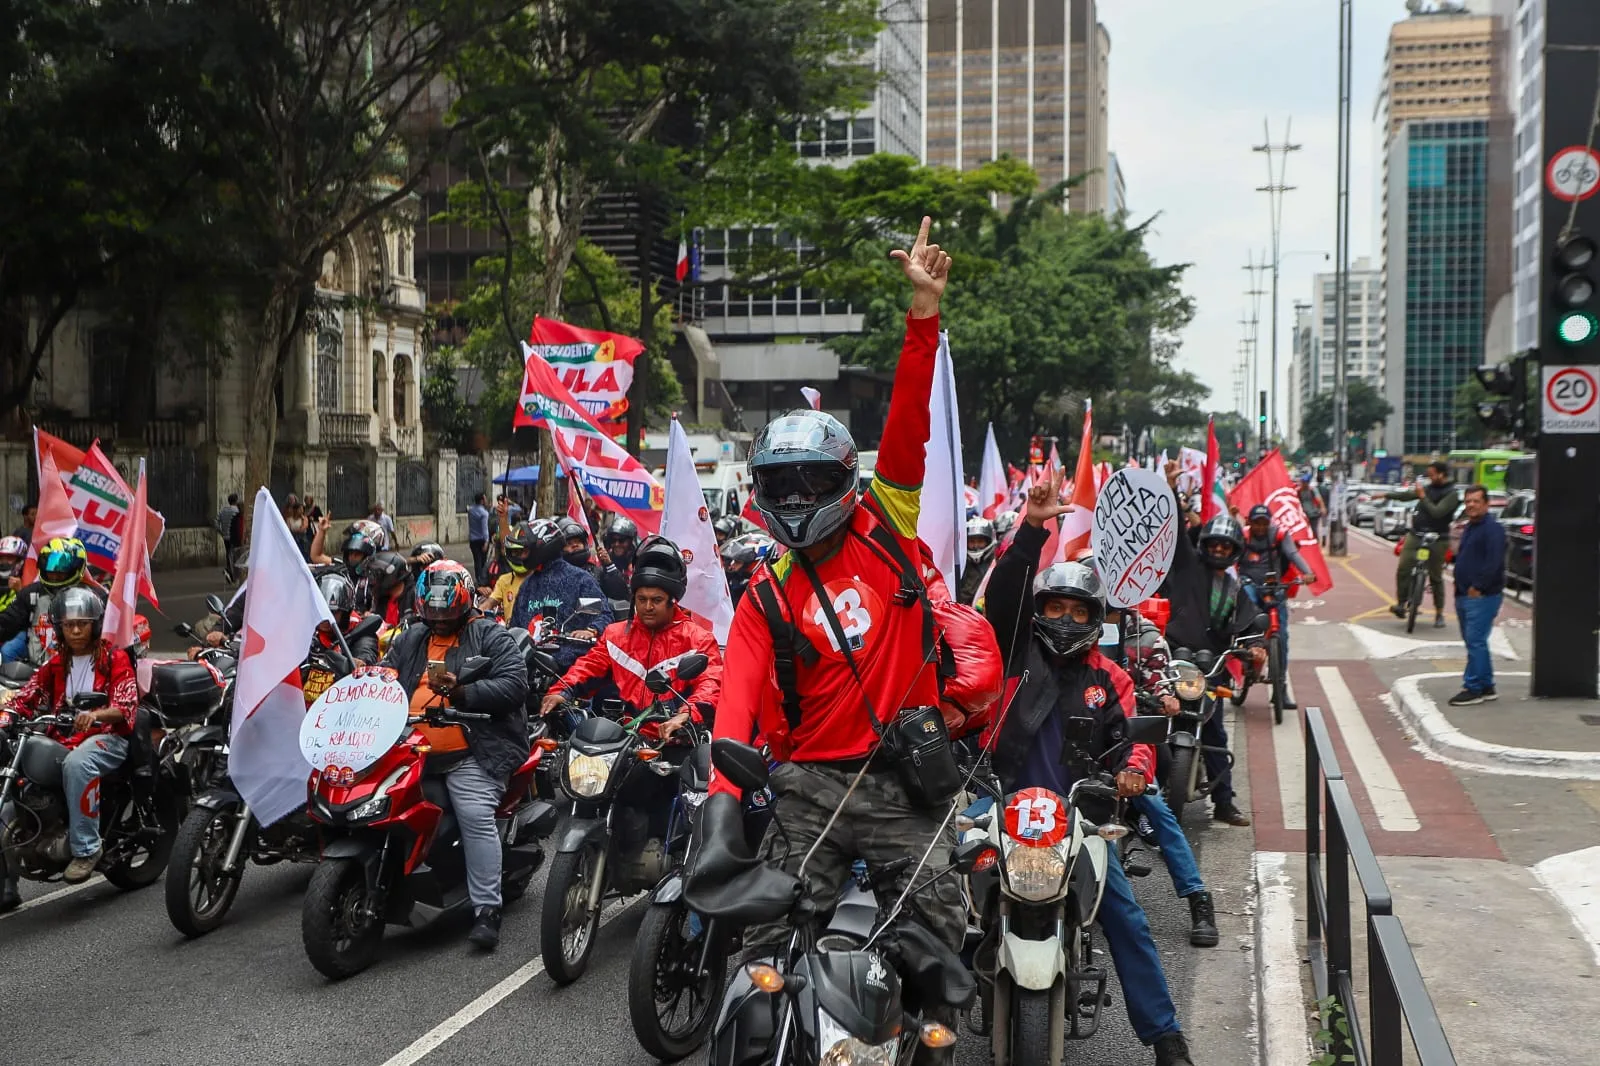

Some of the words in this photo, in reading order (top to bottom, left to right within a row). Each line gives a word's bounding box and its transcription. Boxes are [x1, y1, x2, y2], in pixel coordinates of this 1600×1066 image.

[1556, 379, 1588, 399] 20
[1096, 471, 1134, 531] QUEM
[1111, 487, 1156, 537] LUTA
[1124, 494, 1171, 556] MORTO
[1127, 562, 1154, 597] 13
[813, 588, 872, 653] 13
[1014, 797, 1058, 836] 13
